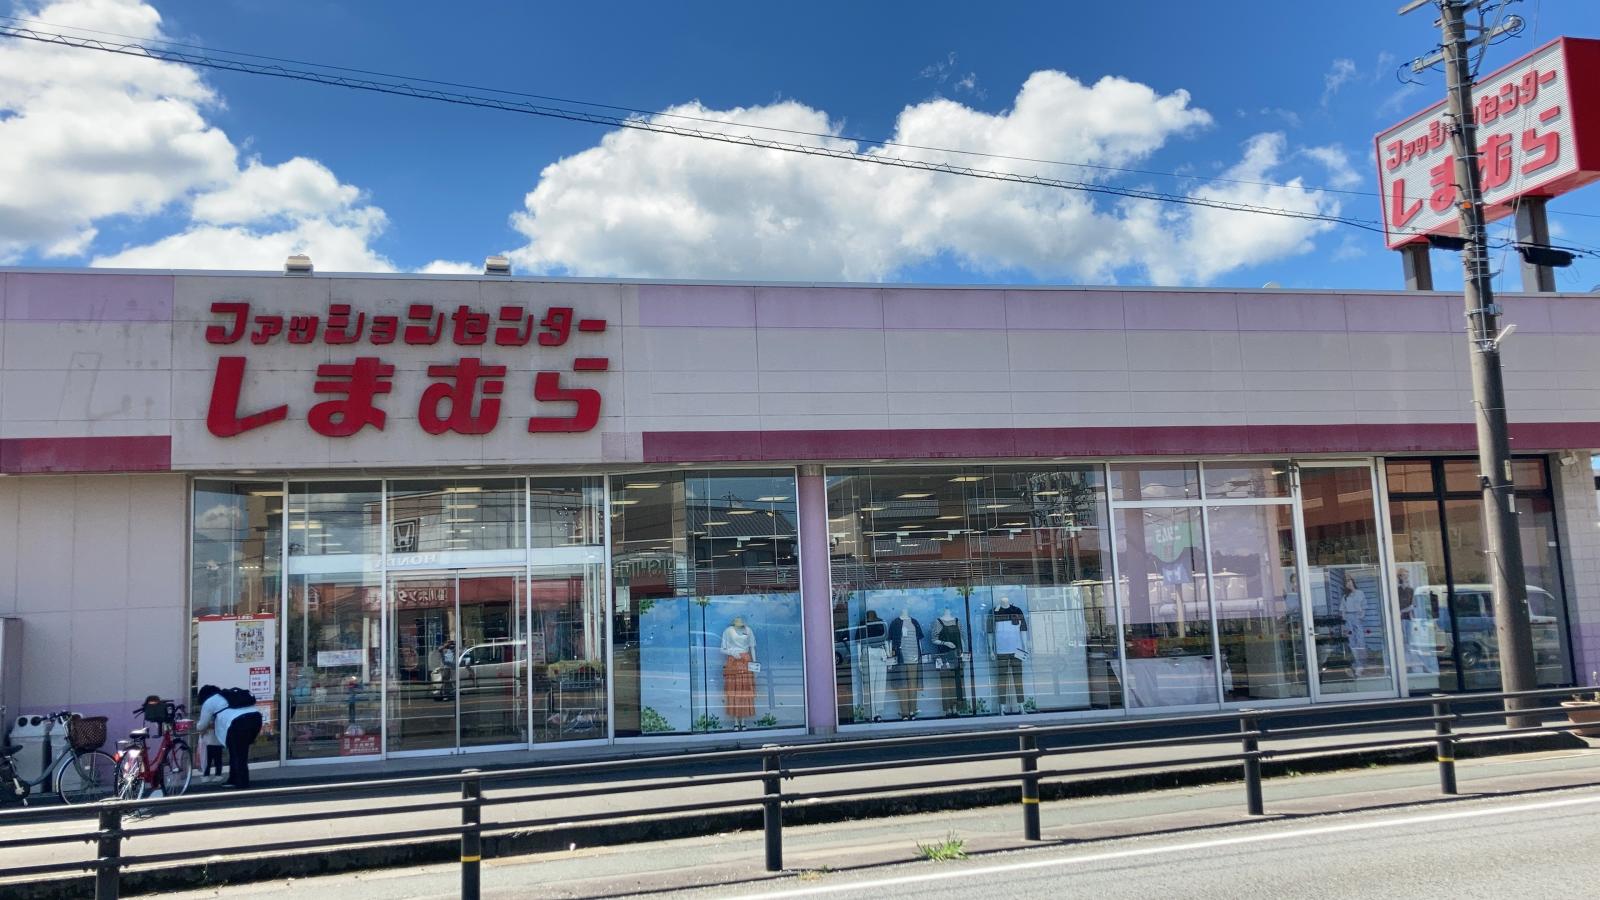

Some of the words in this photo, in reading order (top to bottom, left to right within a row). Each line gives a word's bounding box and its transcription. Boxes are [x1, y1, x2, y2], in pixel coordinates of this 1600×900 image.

[1386, 69, 1557, 171] ファッシセンター
[205, 302, 607, 346] ファッションセンター
[206, 356, 609, 438] しまむら
